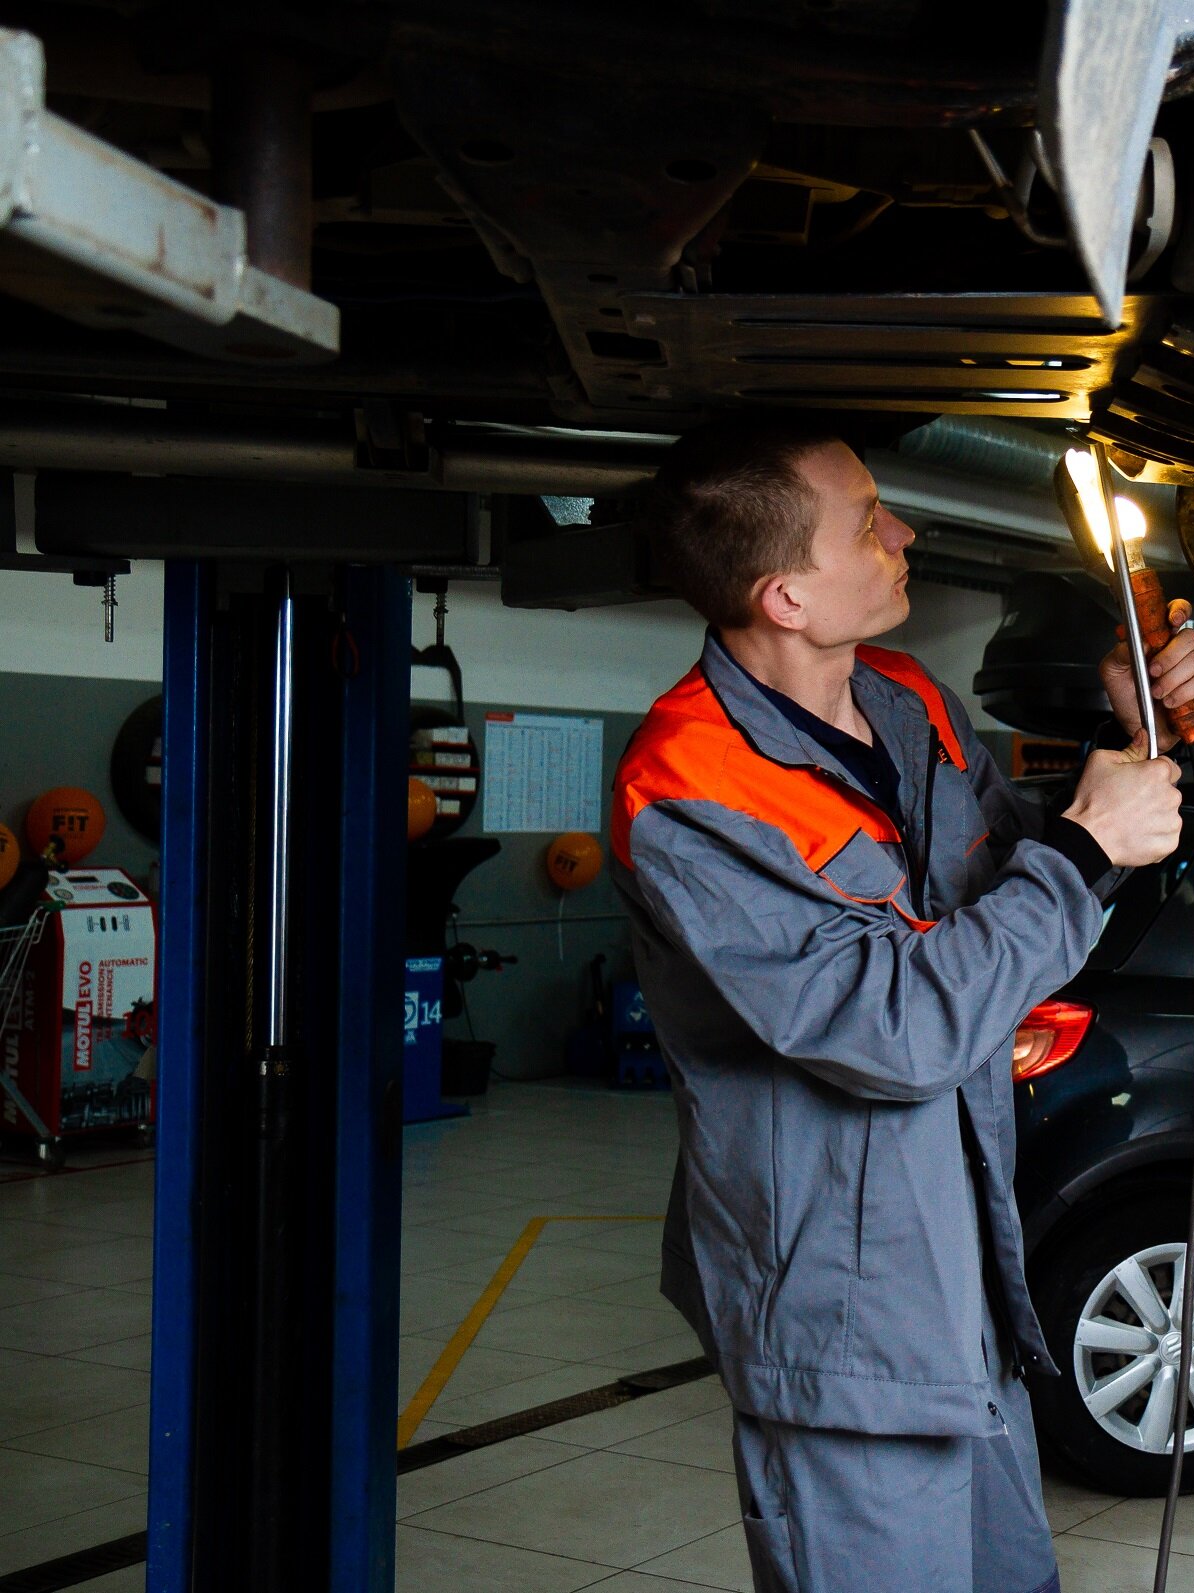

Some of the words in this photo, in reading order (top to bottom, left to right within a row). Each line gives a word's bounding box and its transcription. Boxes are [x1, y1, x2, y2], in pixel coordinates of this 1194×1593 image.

[78, 961, 92, 998] EVO
[98, 957, 149, 968] AUTOMATIC
[420, 999, 443, 1026] 14
[75, 1003, 92, 1068] MOTUL
[3, 1034, 20, 1124] MTUL
